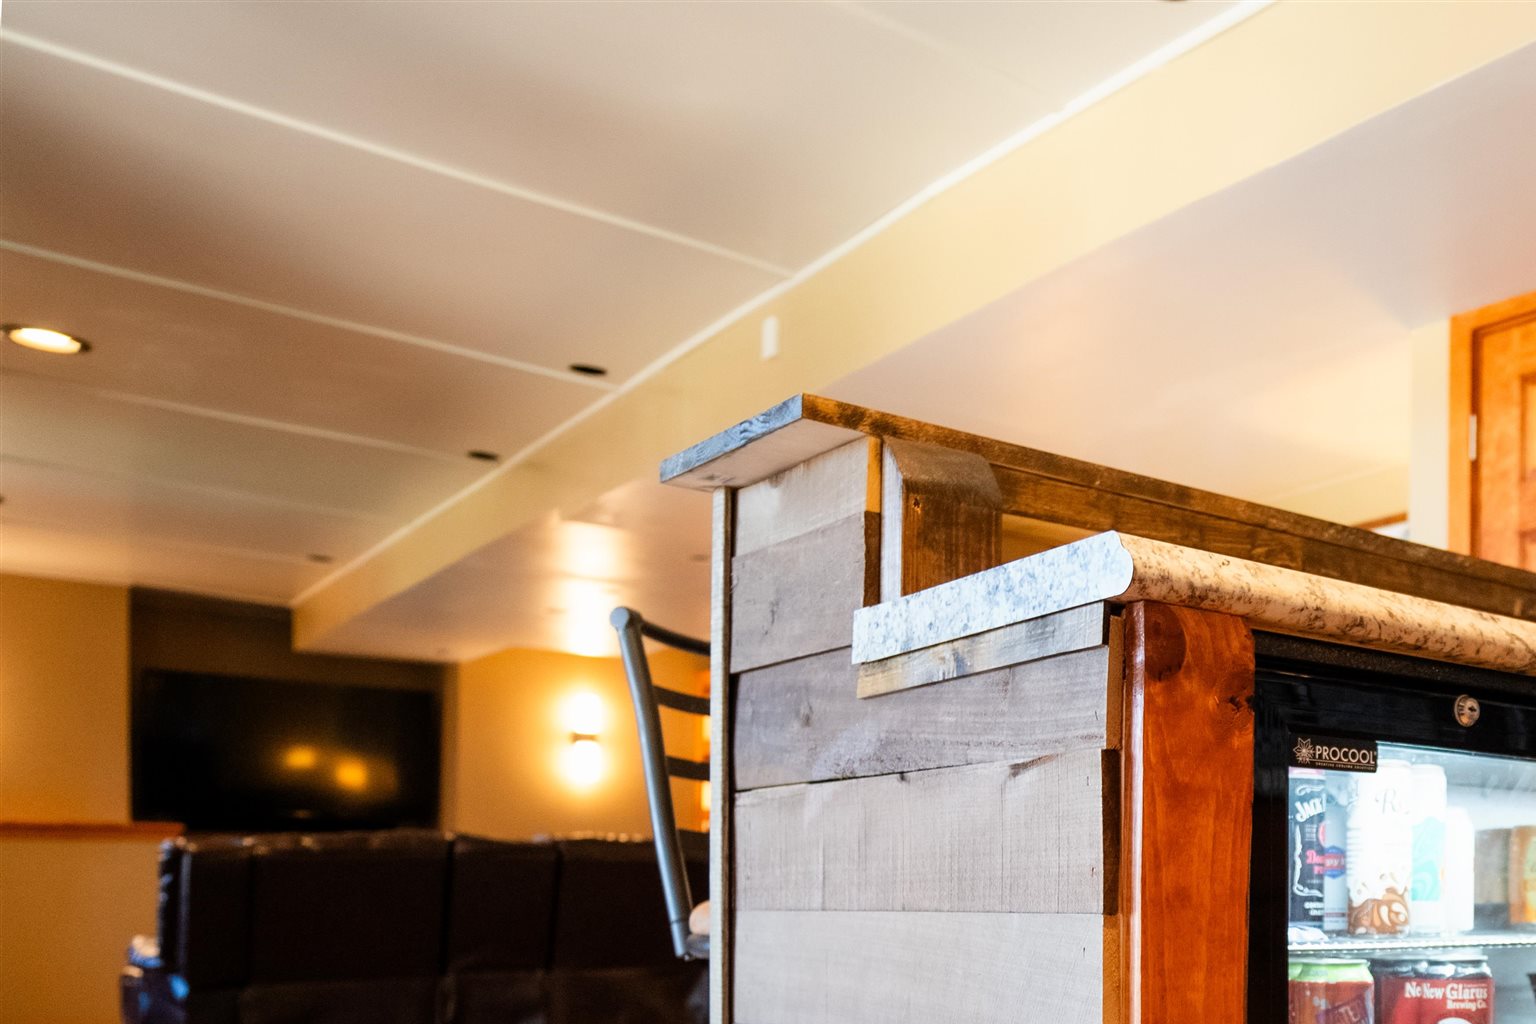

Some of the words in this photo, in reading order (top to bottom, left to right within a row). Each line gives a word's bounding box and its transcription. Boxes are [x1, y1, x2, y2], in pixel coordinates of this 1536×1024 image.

[1315, 745, 1375, 764] PROCOOL
[1423, 983, 1445, 999] New
[1446, 983, 1488, 999] Glarus
[1446, 1000, 1476, 1012] Brewing
